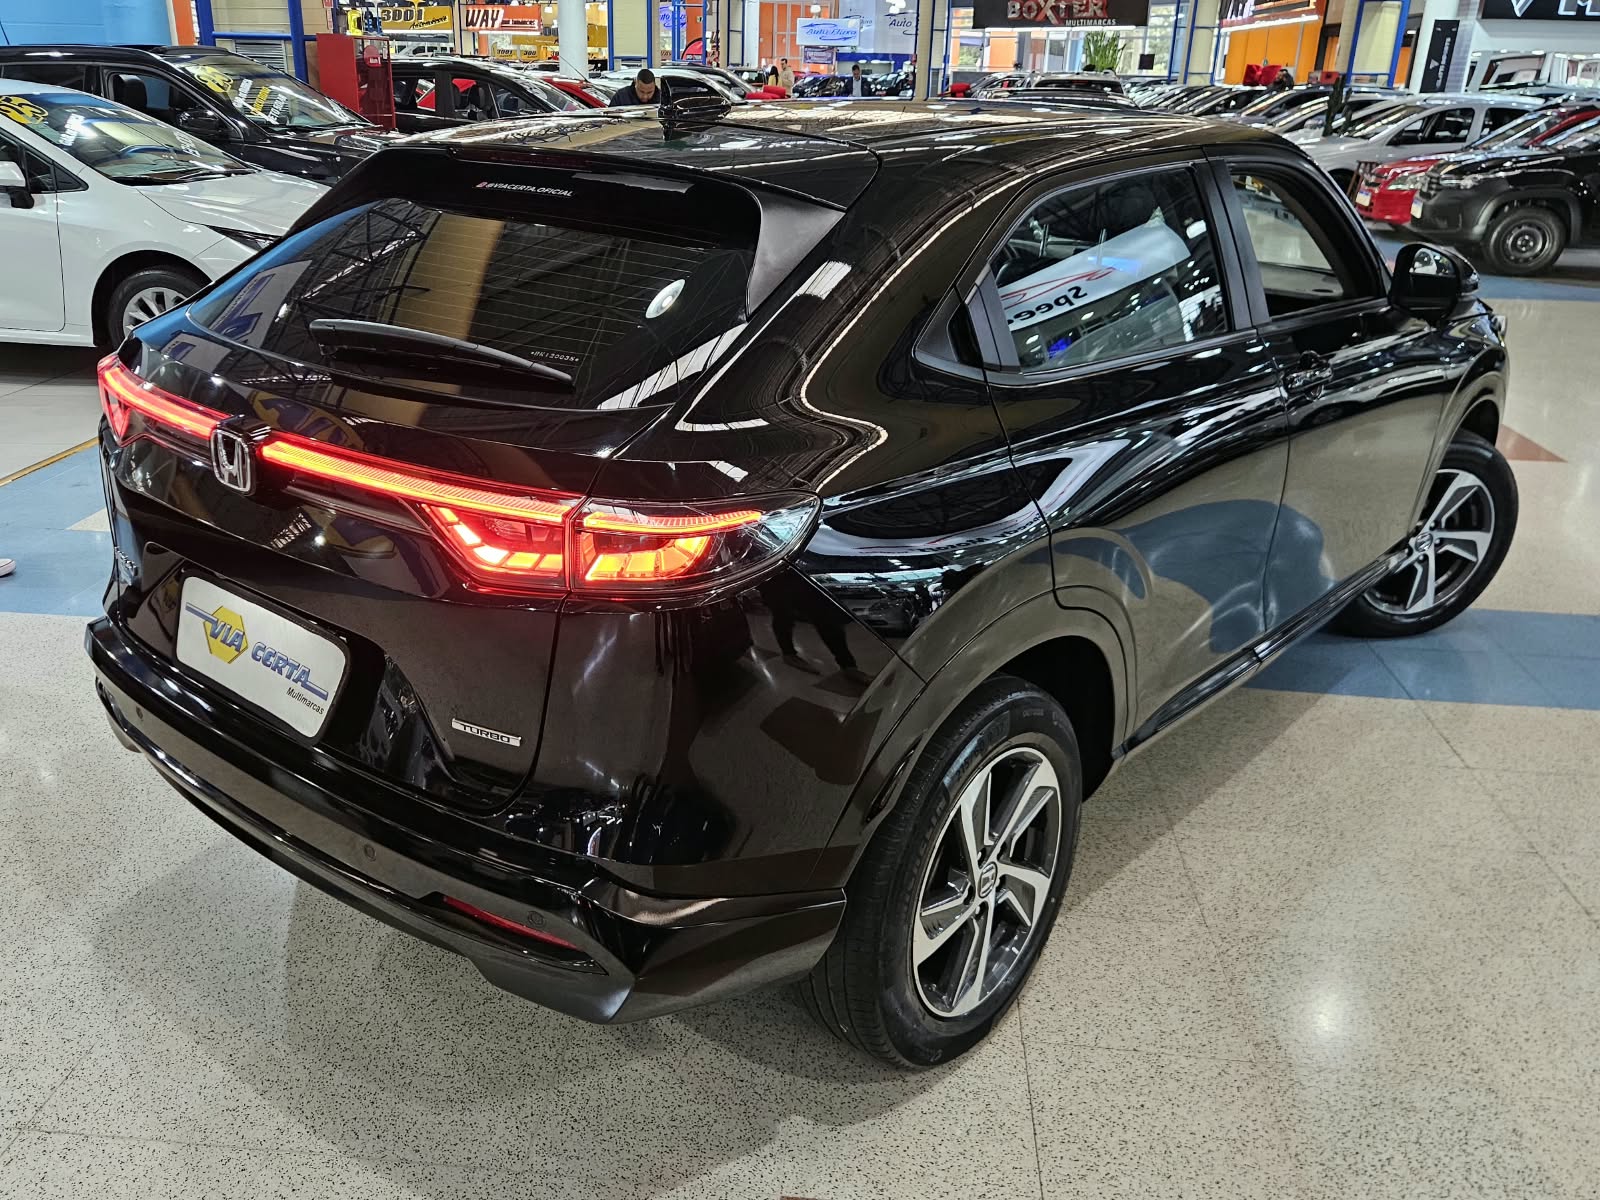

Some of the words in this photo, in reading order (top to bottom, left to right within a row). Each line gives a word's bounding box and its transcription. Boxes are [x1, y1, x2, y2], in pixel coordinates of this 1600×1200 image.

[466, 9, 501, 28] WAY
[1007, 0, 1108, 25] BOXTER
[209, 620, 246, 653] VIA
[251, 641, 311, 688] CERTA
[286, 686, 325, 716] Multimarcas
[461, 723, 510, 743] TURBO
